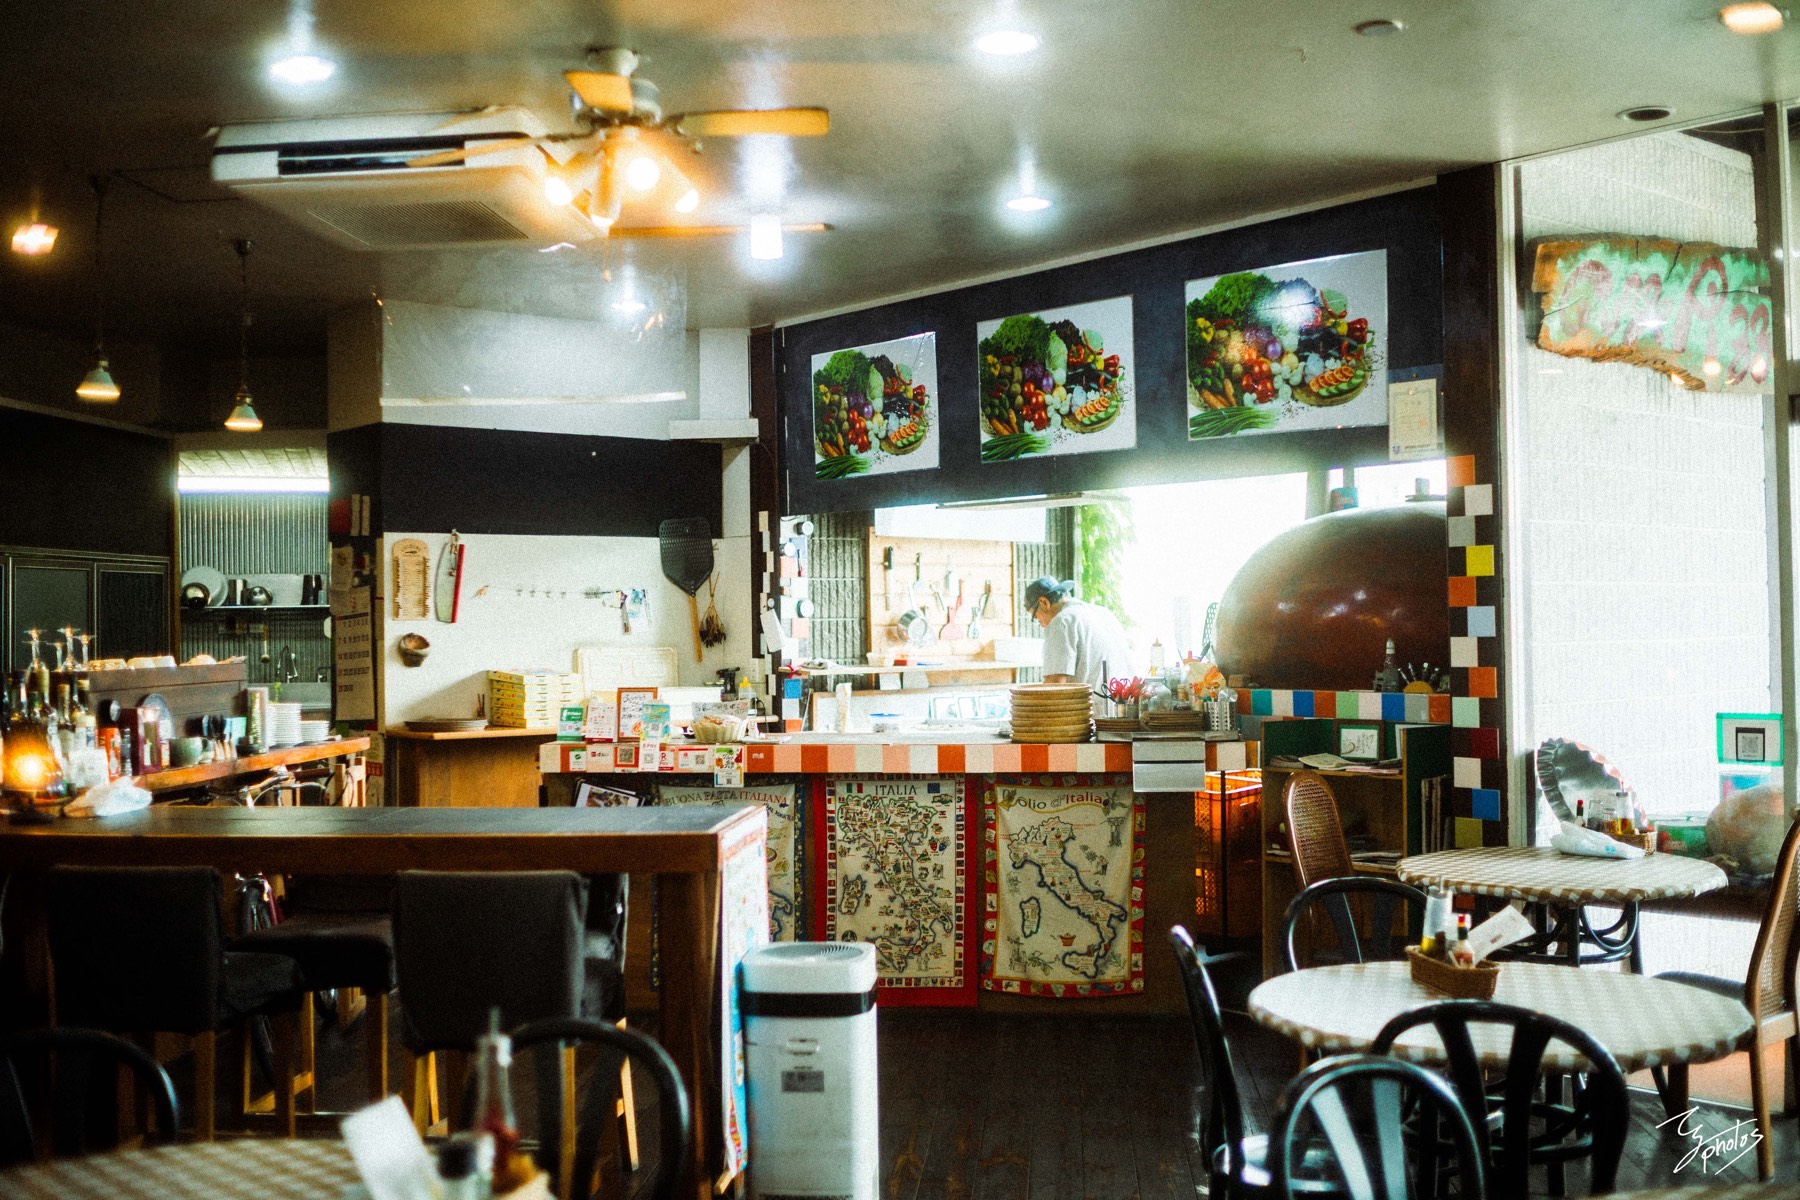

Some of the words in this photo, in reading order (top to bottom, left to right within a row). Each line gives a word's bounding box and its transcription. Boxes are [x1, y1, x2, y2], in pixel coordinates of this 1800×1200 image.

[875, 784, 918, 795] ITALIA
[665, 792, 703, 805] BUONA
[703, 790, 738, 801] PASTA
[739, 791, 788, 805] ITALIANA
